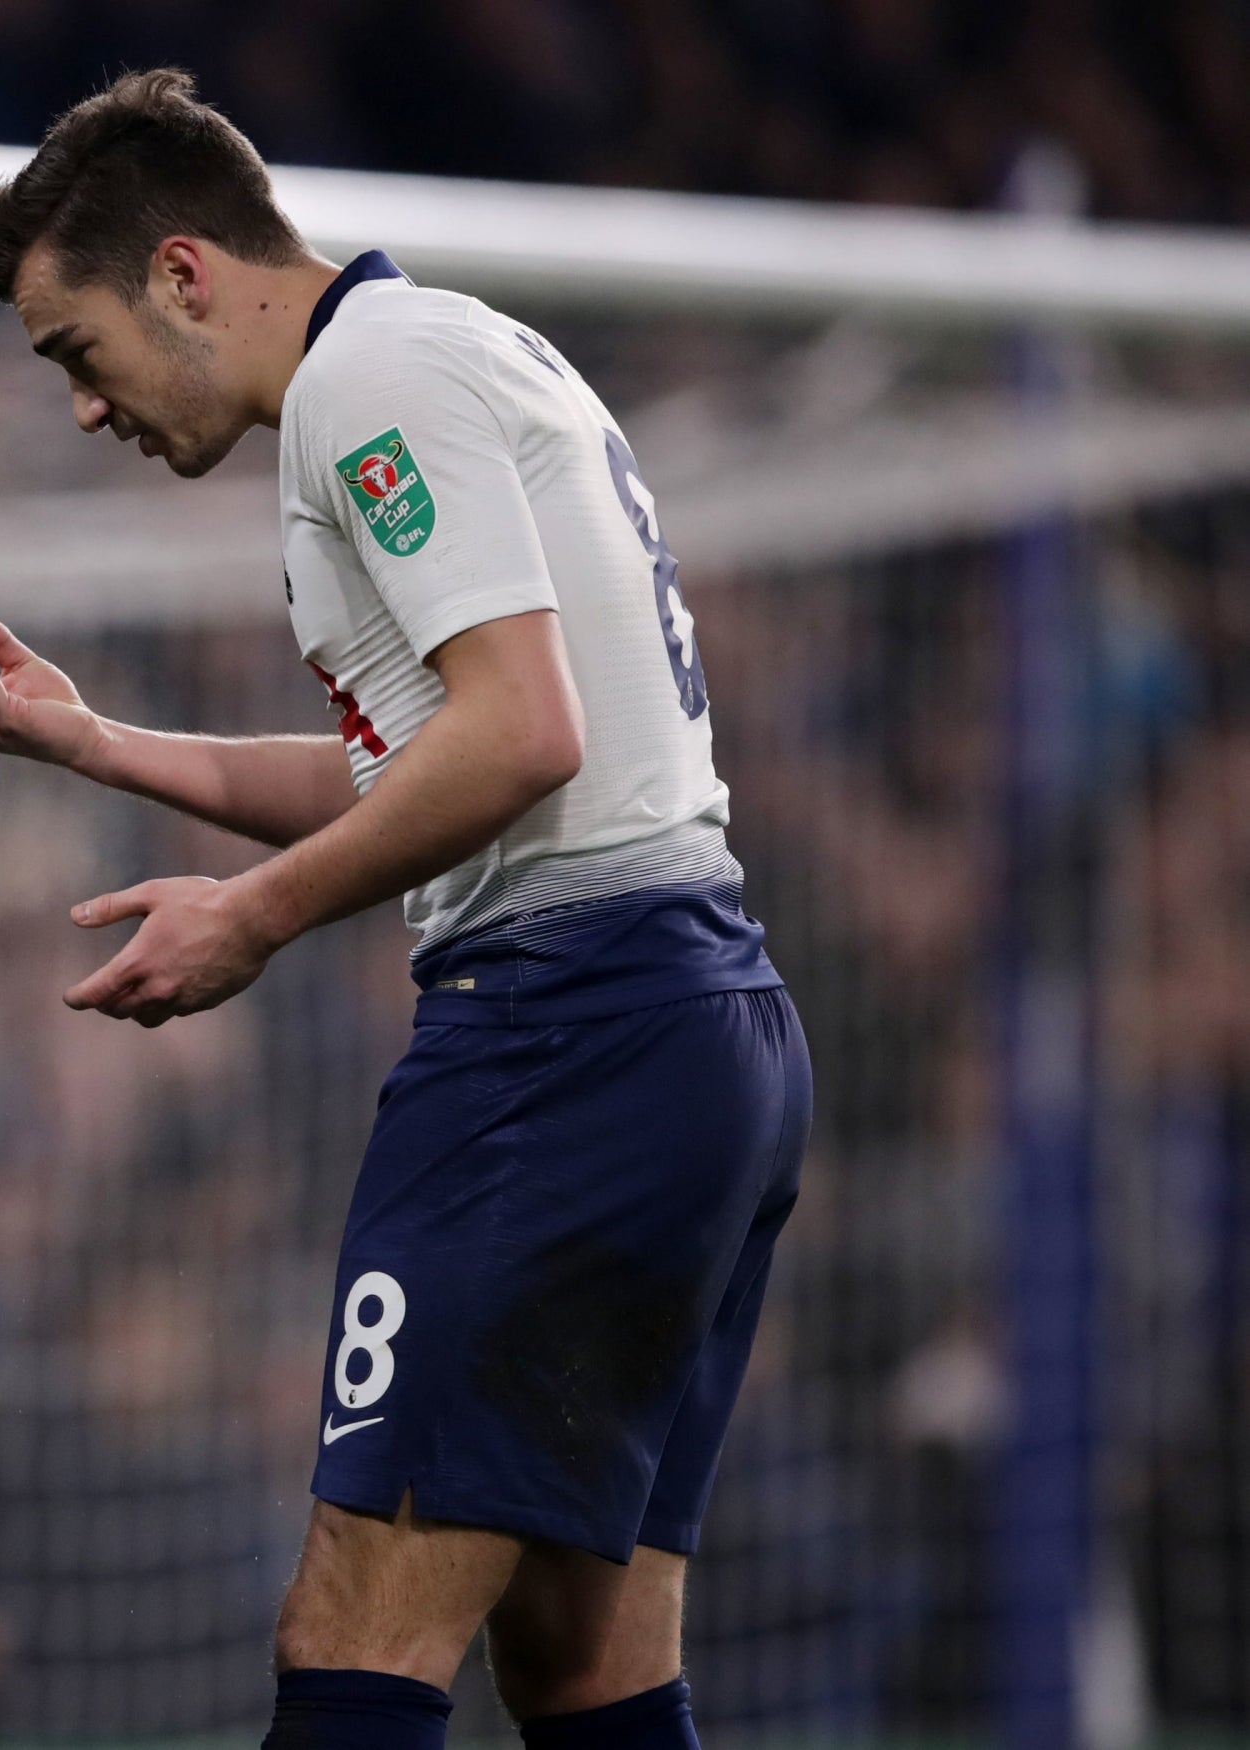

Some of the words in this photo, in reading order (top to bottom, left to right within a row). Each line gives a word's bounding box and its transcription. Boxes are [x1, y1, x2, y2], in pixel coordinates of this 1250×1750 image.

[366, 471, 418, 525] Carabao
[384, 499, 410, 528] Cup
[408, 527, 425, 542] EFL
[602, 427, 708, 721] 8
[335, 1271, 406, 1409] 8
